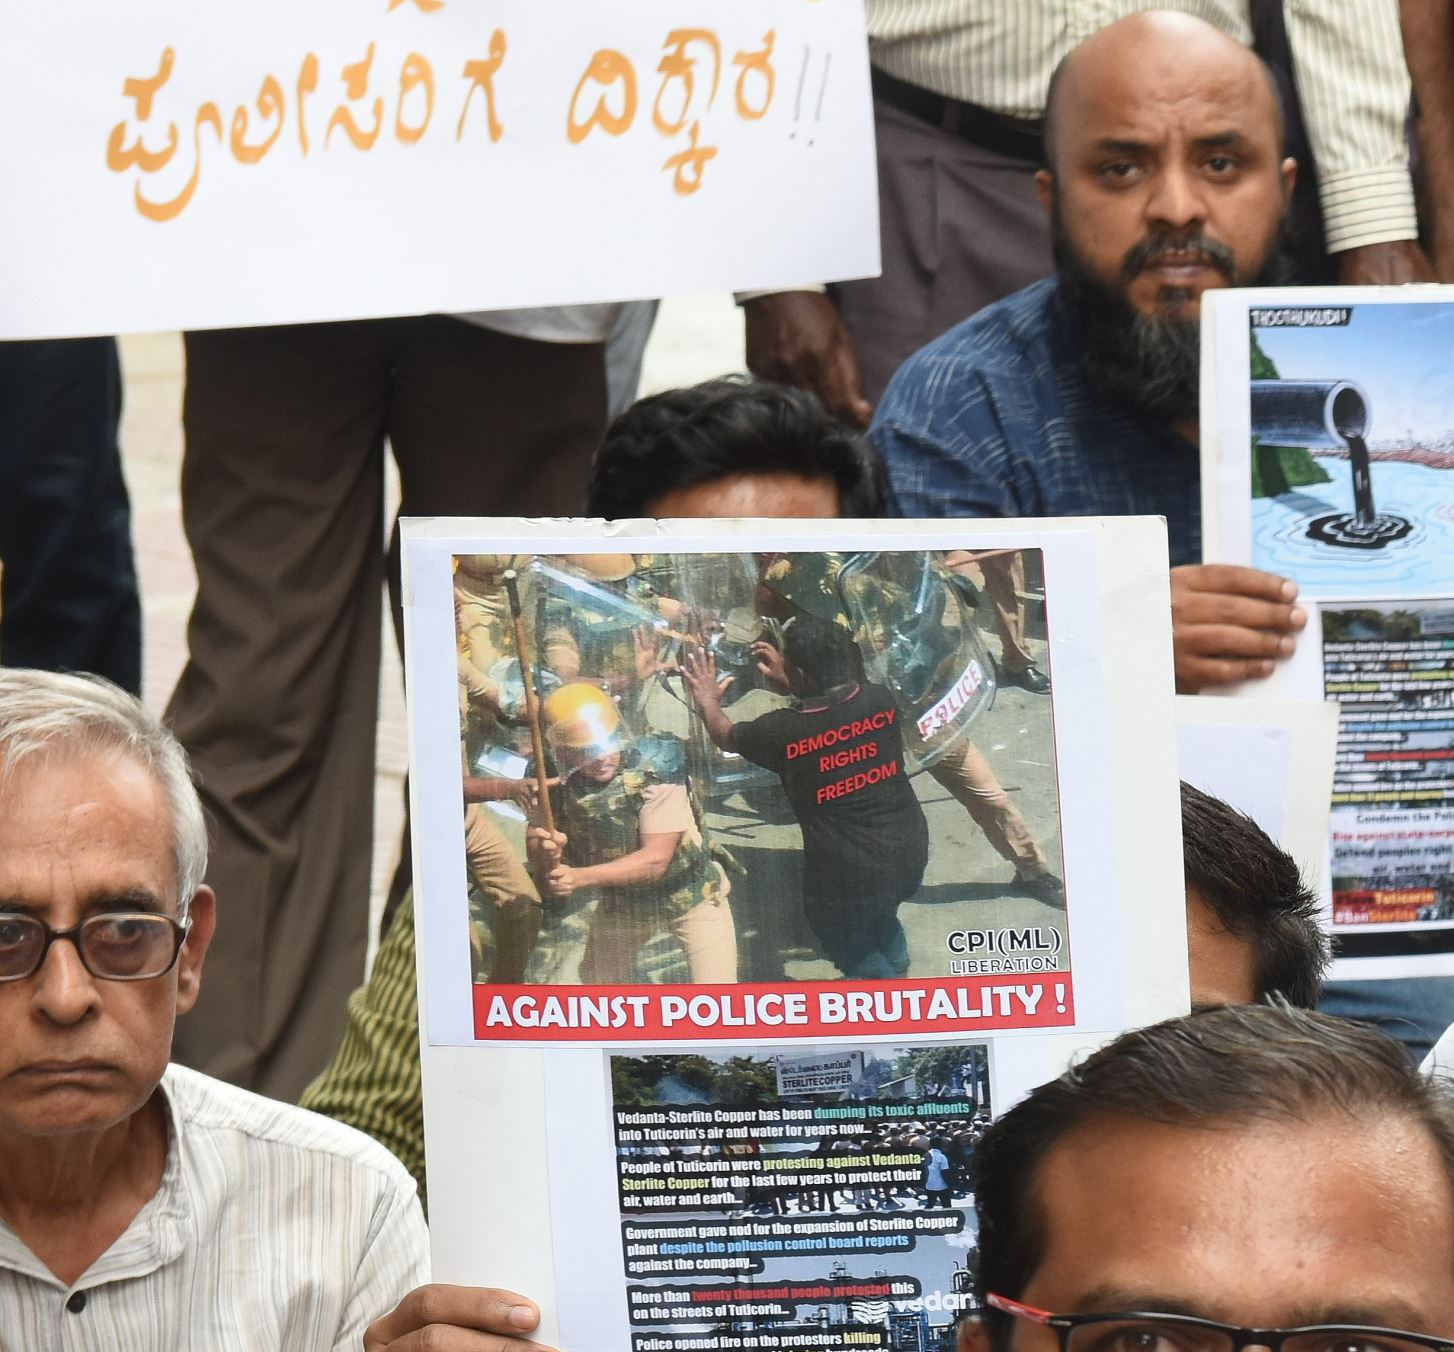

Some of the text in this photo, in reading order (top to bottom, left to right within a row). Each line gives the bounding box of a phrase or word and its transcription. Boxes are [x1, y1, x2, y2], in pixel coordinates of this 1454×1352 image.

[787, 709, 896, 760] DEMOCRACY
[820, 743, 877, 772] RIGHTS
[817, 760, 897, 805] FREEDOM
[947, 926, 1062, 956] CPI(ML)
[950, 956, 1058, 976] LIBERATION
[486, 983, 1066, 1028] AGAINST POLICE BRUTALITY !
